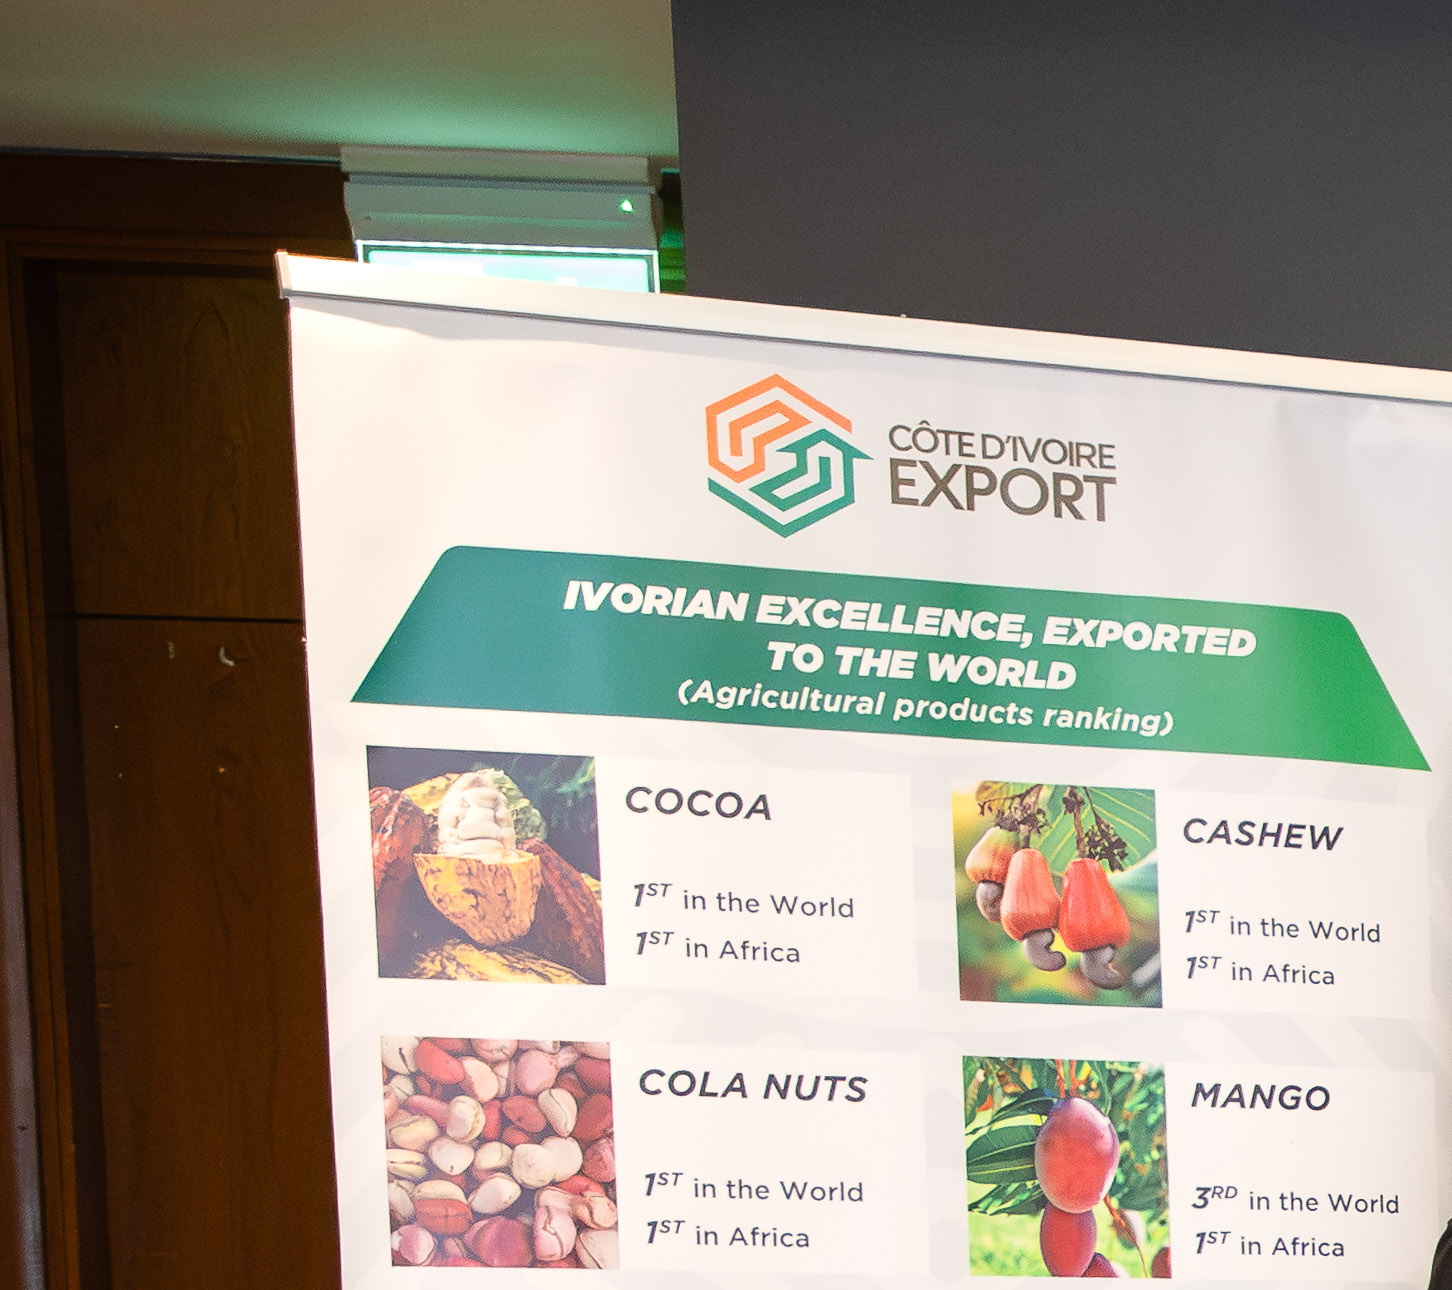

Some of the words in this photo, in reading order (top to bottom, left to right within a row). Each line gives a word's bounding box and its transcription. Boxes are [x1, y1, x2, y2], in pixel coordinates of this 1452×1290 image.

[889, 419, 976, 459] CÔTE
[980, 433, 1117, 469] D'IVOIRE
[889, 458, 1118, 522] EXPORT
[563, 580, 749, 621] IVORIAN
[756, 595, 1033, 648] EXCELLENCE,
[1043, 617, 1256, 656] EXPORTED
[768, 641, 824, 673] TO
[835, 646, 918, 679] THE
[929, 653, 1076, 689] WORLD
[678, 679, 886, 715] (Agricultural
[893, 698, 1033, 725] products
[1043, 707, 1173, 736] ranking)
[626, 787, 771, 820] COCOA
[1184, 818, 1344, 850] CASHEW
[634, 883, 672, 907] 1ST
[684, 890, 706, 910] in
[716, 892, 759, 913] the
[770, 895, 853, 918] World
[637, 931, 674, 955] 1ST
[686, 938, 708, 958] in
[720, 941, 799, 962] Africa
[640, 1069, 747, 1098] COLA
[764, 1074, 868, 1102] NUTS
[1192, 1083, 1330, 1111] MANGO
[1192, 1186, 1237, 1209] 3RD
[1250, 1192, 1269, 1210] in
[1280, 1192, 1318, 1211] the
[1328, 1194, 1398, 1214] World
[1196, 1231, 1231, 1254] 1ST
[1241, 1236, 1261, 1255] in
[1272, 1237, 1344, 1256] Africa
